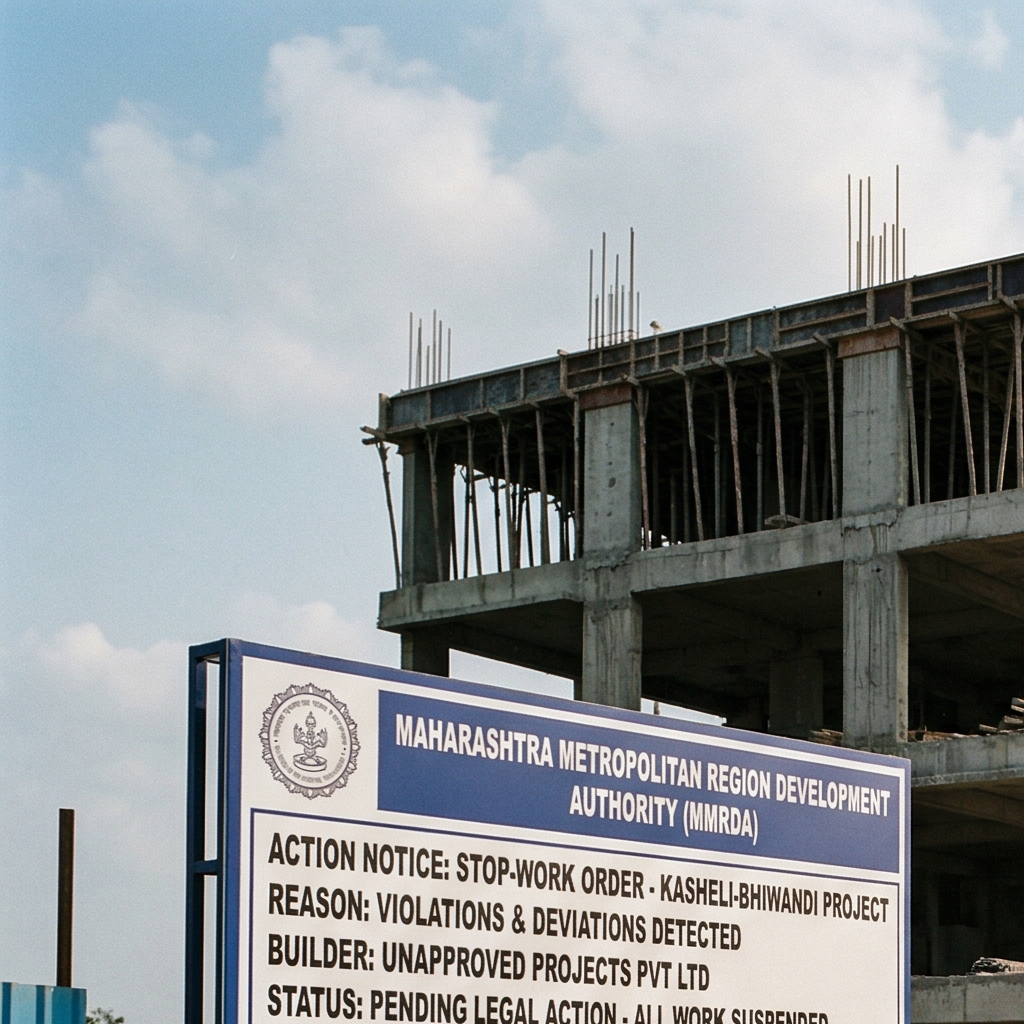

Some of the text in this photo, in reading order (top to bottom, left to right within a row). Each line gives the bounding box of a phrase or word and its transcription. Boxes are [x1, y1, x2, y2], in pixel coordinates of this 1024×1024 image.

[396, 714, 553, 767] MAHARASHTRA
[559, 739, 701, 789] METROPOLITAN
[708, 763, 770, 799] REGION
[776, 773, 890, 817] DEVELOPMENT
[570, 786, 758, 845] AUTHORITY (MMRDA)
[268, 833, 355, 871] ACTION
[364, 843, 449, 880] NOTICE:
[457, 852, 575, 892] STOP-WORK
[582, 866, 644, 899] ORDER
[661, 874, 817, 915] KASHELI-BHIWANDI
[824, 892, 888, 922] PROJECT
[269, 883, 741, 950] REASON: VIOLATIONS & DEVIATIONS DETECTED
[269, 934, 709, 990] BUILDER: UNAPPROVED PROJECTS PVT LTD
[268, 984, 362, 1019] STATUS:
[371, 990, 467, 1024] PENDING
